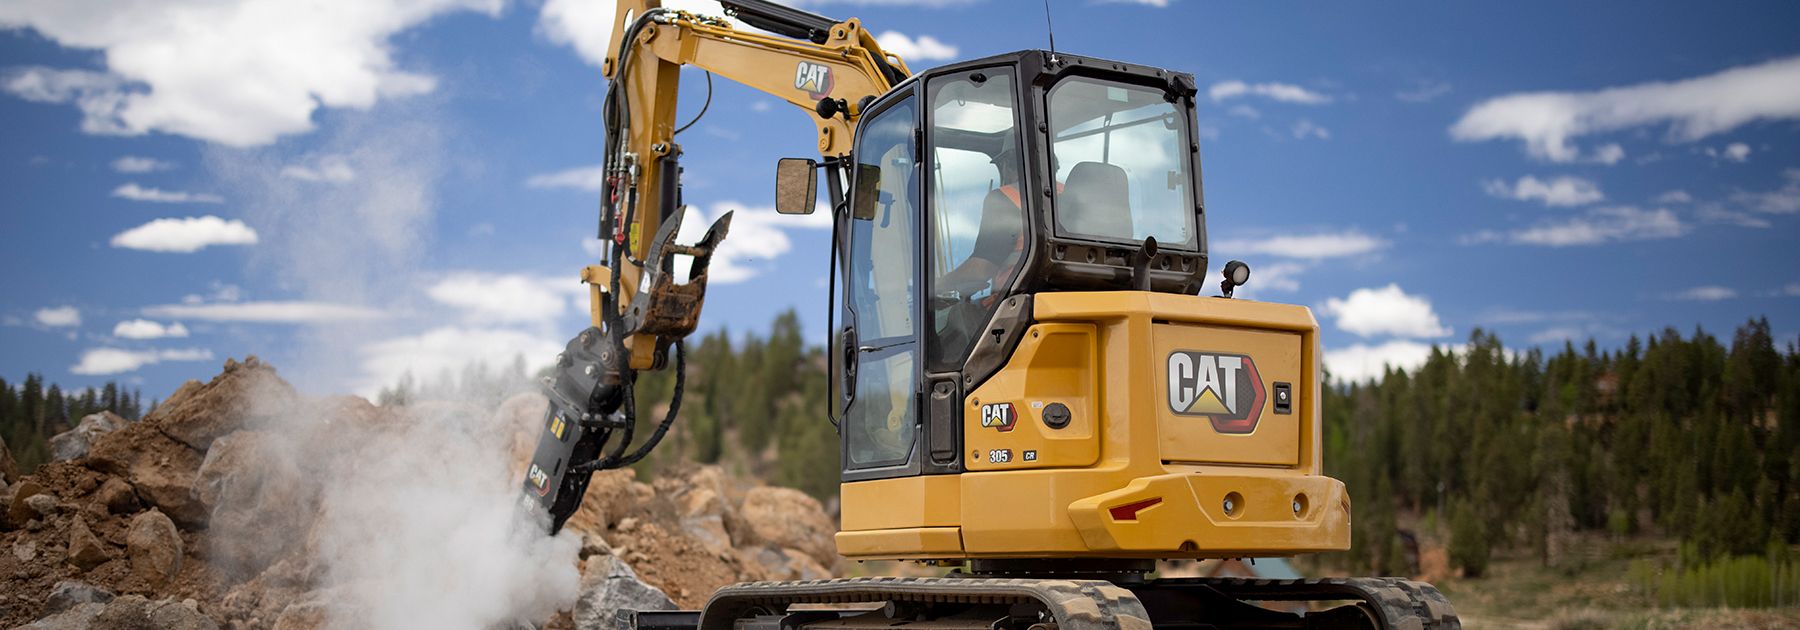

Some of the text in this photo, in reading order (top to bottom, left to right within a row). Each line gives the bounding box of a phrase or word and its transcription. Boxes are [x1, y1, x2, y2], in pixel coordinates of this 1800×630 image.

[795, 62, 828, 92] CAT
[1169, 352, 1242, 414] CAT
[982, 404, 1009, 427] CAT
[990, 450, 1035, 463] 305 CR
[529, 464, 548, 489] CAT
